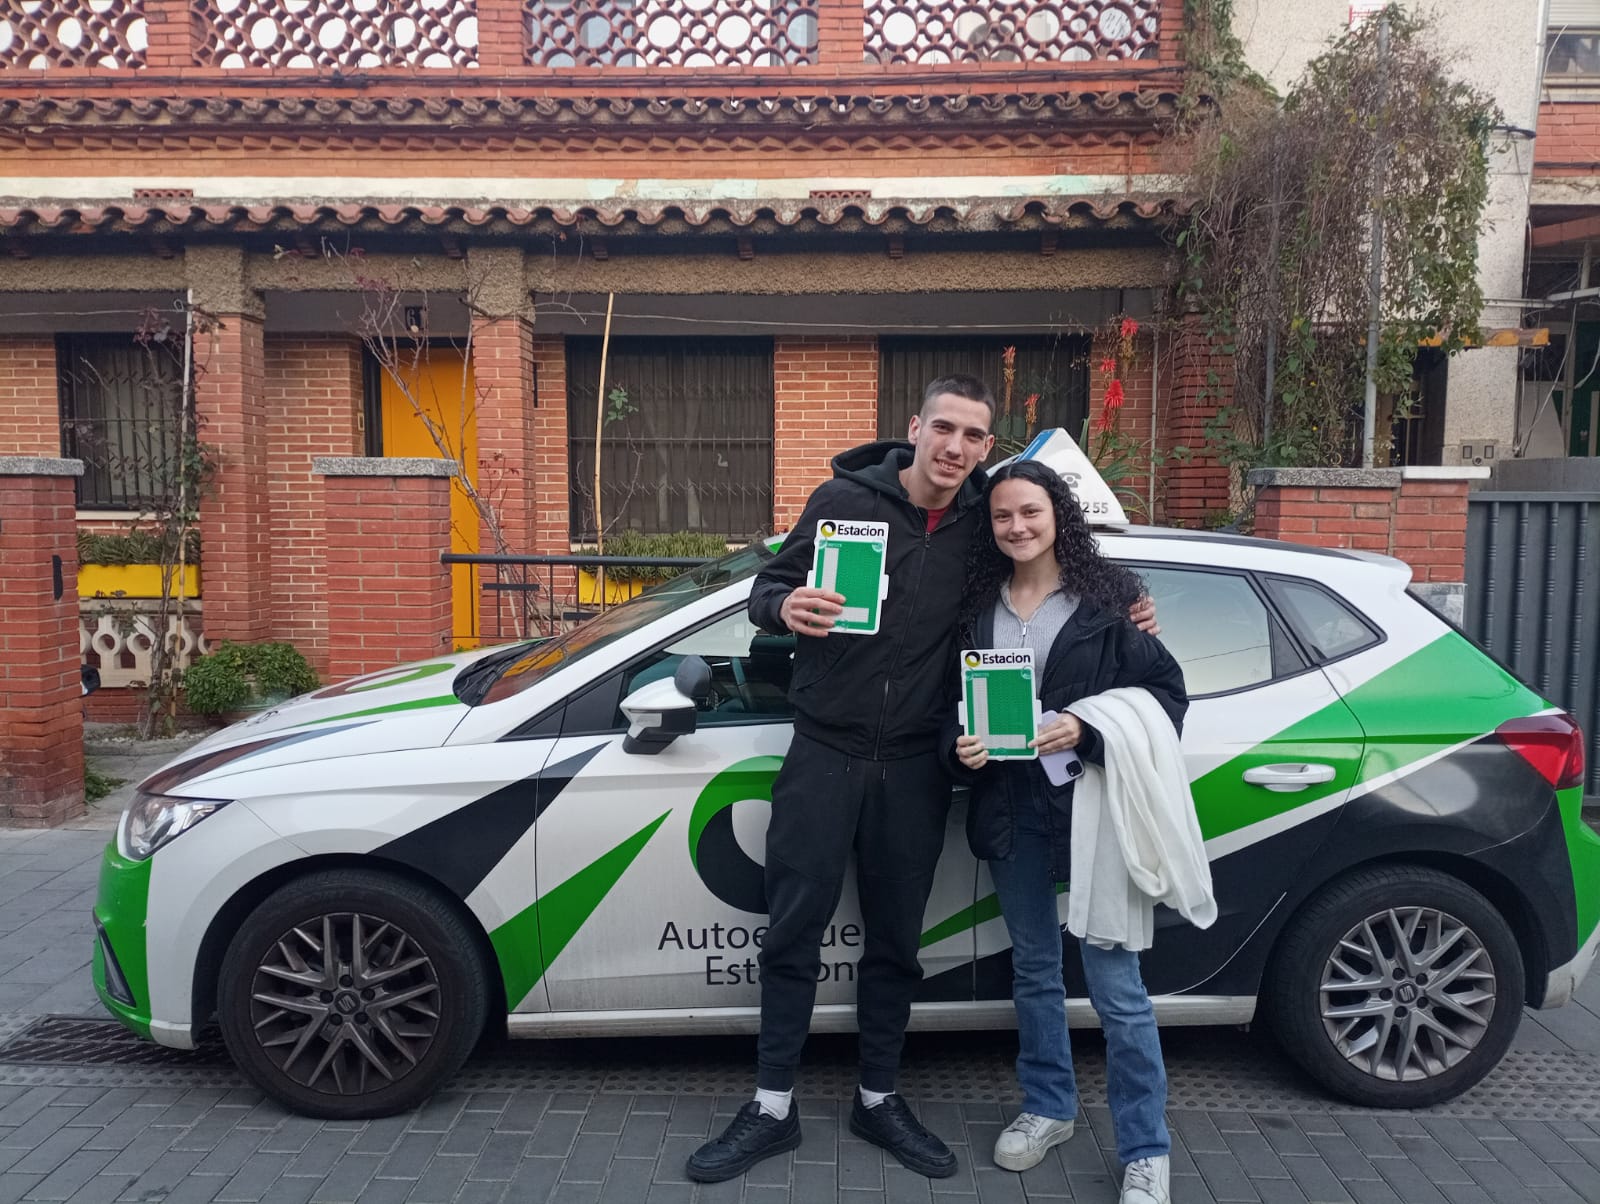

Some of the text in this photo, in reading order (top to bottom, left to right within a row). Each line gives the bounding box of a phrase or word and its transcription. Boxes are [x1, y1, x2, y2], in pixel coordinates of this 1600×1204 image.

[837, 524, 885, 537] Estacion
[982, 652, 1031, 665] Estacion
[658, 921, 861, 951] Autoeue
[706, 955, 854, 986] Eston
